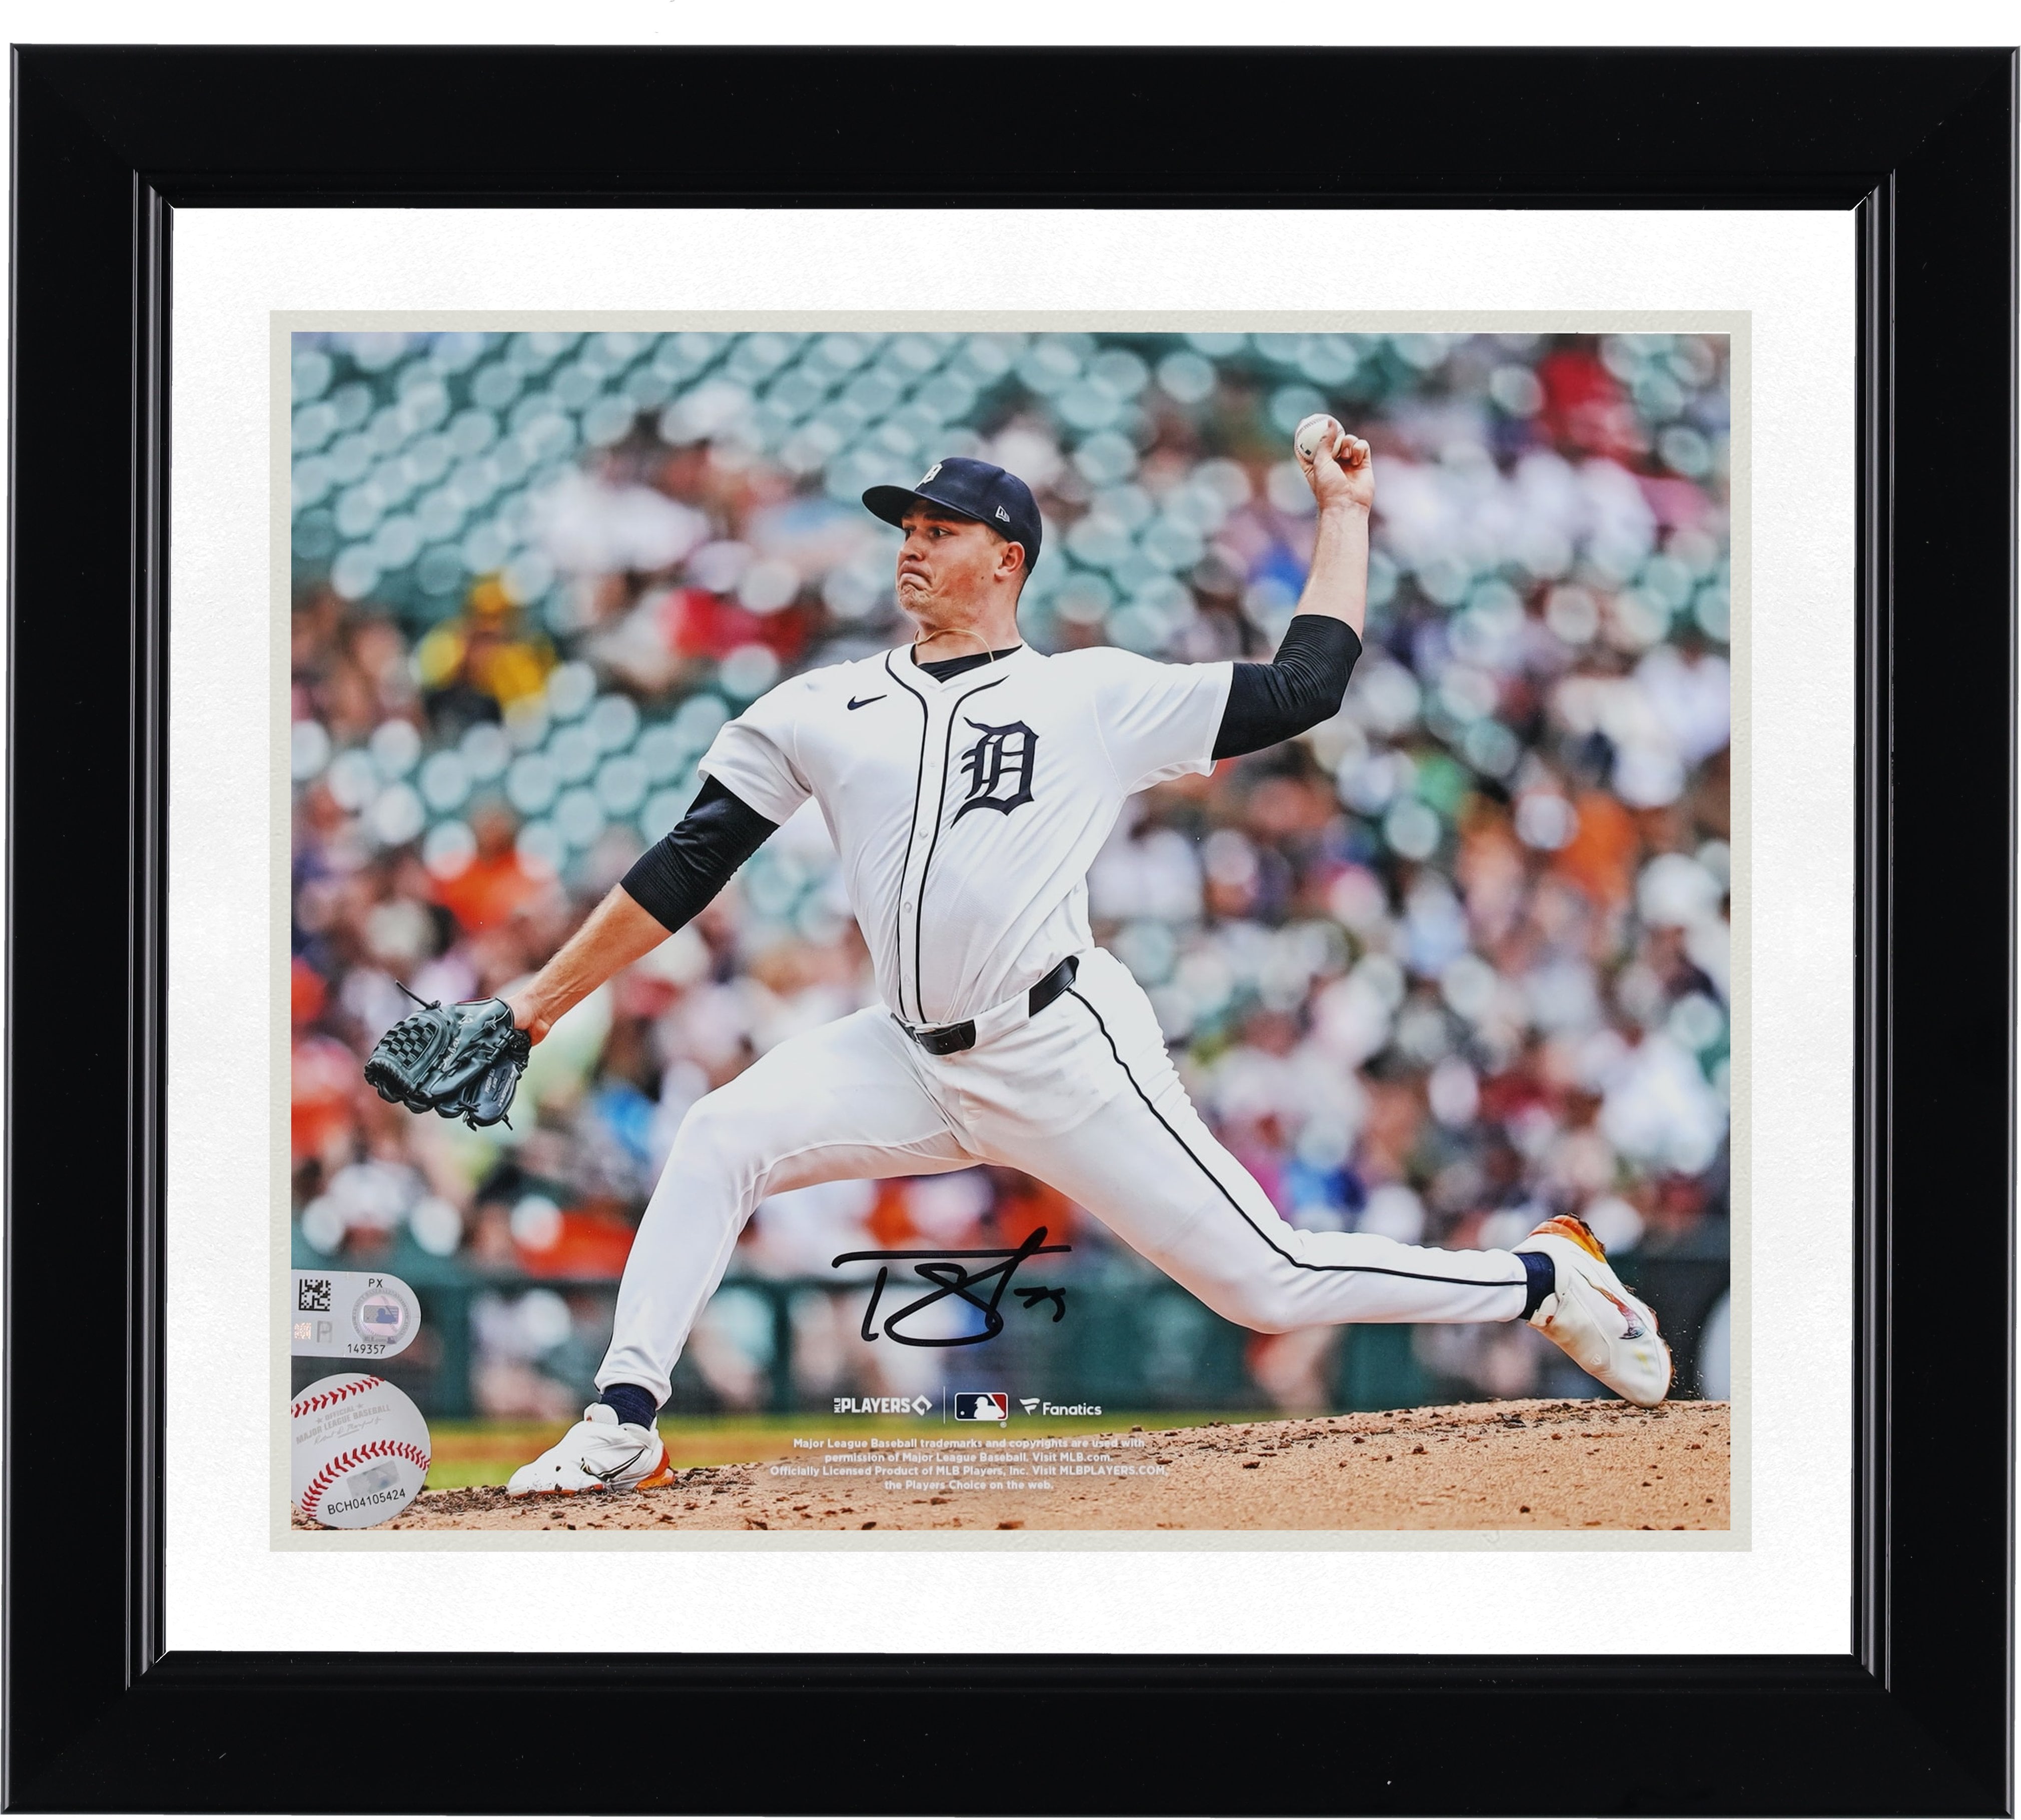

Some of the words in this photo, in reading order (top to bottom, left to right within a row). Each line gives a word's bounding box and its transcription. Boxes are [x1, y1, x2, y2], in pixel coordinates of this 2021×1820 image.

[950, 717, 1039, 829] D
[368, 1279, 383, 1288] PX
[347, 1344, 386, 1354] 149357
[841, 1398, 911, 1413] PLAYERS
[1042, 1402, 1102, 1416] Fanatics
[325, 1405, 355, 1421] OFFICIAL
[296, 1426, 323, 1445] MAJOR
[324, 1415, 351, 1431] LEAGUE
[353, 1404, 391, 1420] BASEBALL
[794, 1438, 824, 1449] Major
[828, 1438, 868, 1449] League
[871, 1438, 917, 1448] Baseball
[920, 1439, 982, 1448] trademarks
[985, 1439, 1006, 1448] and
[1009, 1439, 1068, 1450] copyrights
[1092, 1439, 1118, 1448] used
[1121, 1439, 1145, 1448] with
[825, 1453, 885, 1464] permission
[888, 1452, 900, 1462] of
[902, 1452, 933, 1463] Major
[936, 1452, 976, 1463] League
[979, 1452, 1029, 1462] Baseball.
[1032, 1452, 1057, 1462] Visit
[1060, 1452, 1113, 1462] MLB.com.
[770, 1466, 820, 1477] Officially
[823, 1466, 872, 1475] Licensed
[875, 1466, 918, 1475] Product
[922, 1466, 934, 1475] of
[936, 1466, 960, 1475] MLB
[963, 1466, 1006, 1477] Players,
[1009, 1466, 1029, 1475] Inc.
[1032, 1466, 1057, 1475] Visit
[884, 1480, 902, 1489] the
[906, 1480, 946, 1491] Players
[949, 1480, 986, 1489] Choice
[1007, 1480, 1025, 1489] the
[1027, 1480, 1054, 1489] web.
[327, 1488, 406, 1515] BCH04105424
